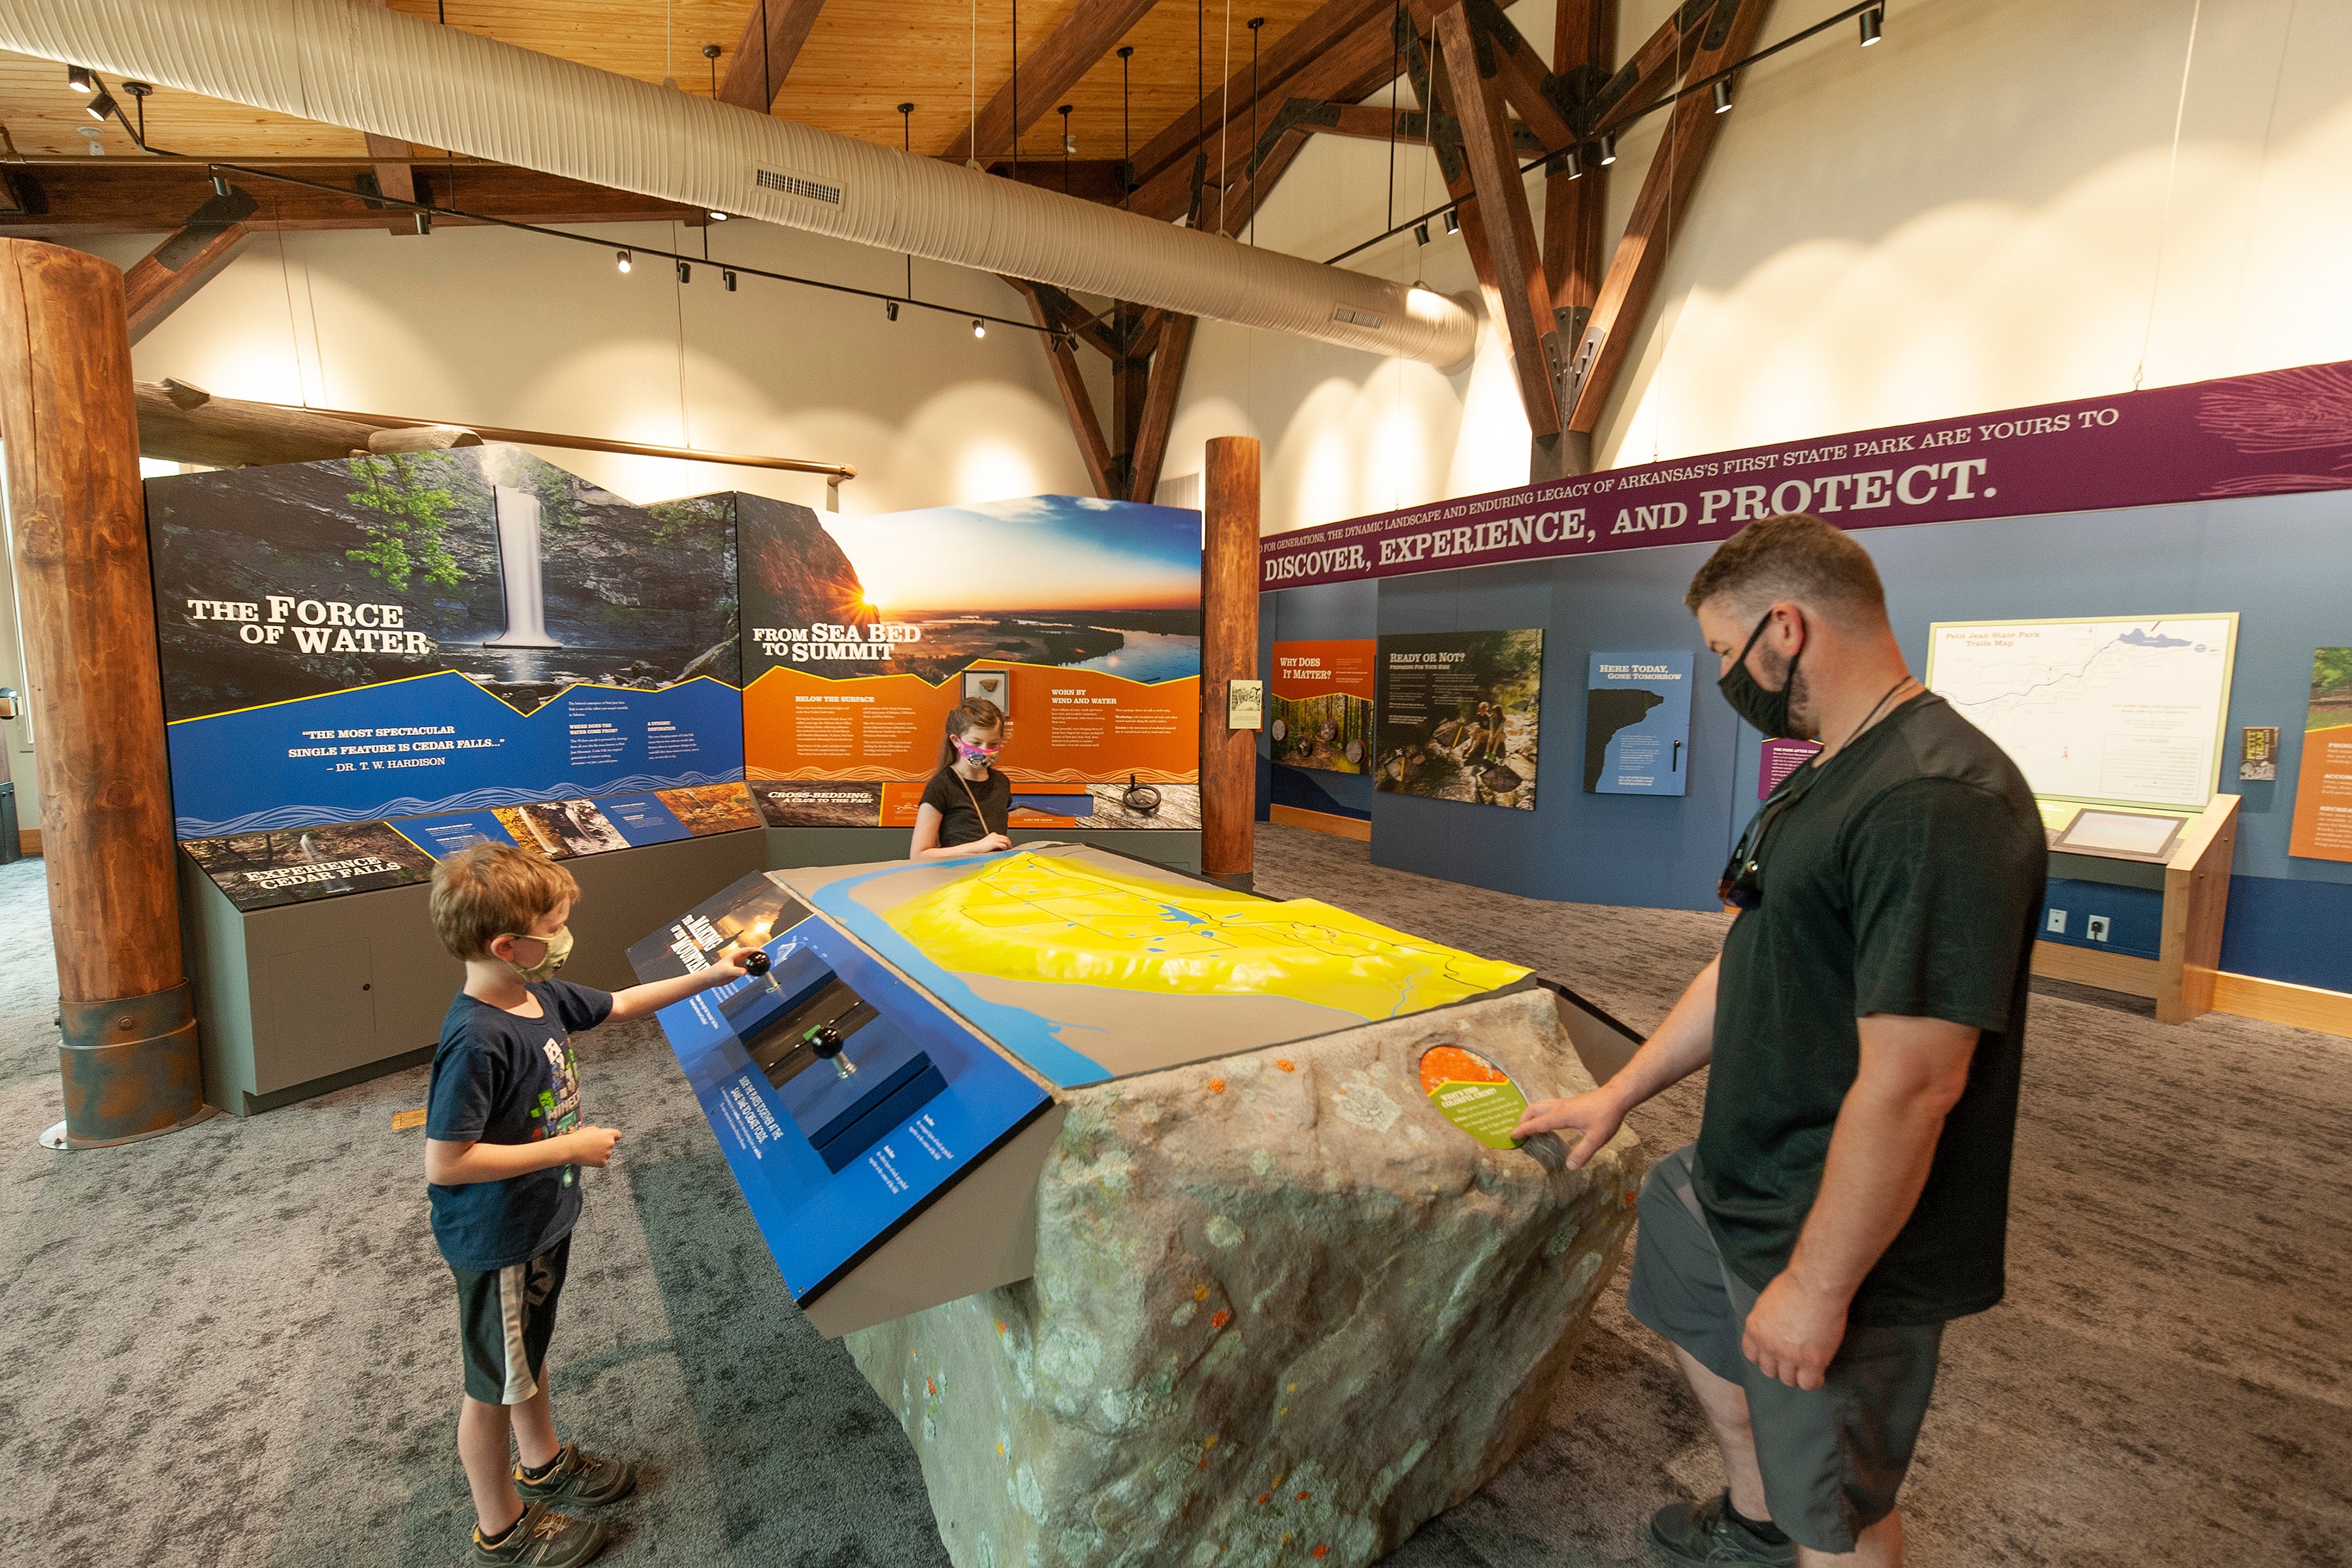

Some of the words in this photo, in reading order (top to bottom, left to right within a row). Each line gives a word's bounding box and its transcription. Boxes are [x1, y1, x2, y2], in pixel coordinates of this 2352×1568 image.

[1264, 542, 1276, 553] FOR
[1277, 533, 1326, 549] GENERATIONS,
[1327, 529, 1343, 541] THE
[1344, 521, 1384, 538] DYNAMIC
[1384, 510, 1441, 531] LANDSCAPE
[1443, 505, 1467, 517] AND
[1469, 493, 1534, 514] ENDURING
[1536, 482, 1592, 503] LEGACY
[1593, 479, 1615, 495] OF
[1722, 453, 1777, 474] FIRST
[1782, 445, 1848, 467] STATE
[1854, 436, 1914, 457] PARK
[1918, 428, 1972, 448] ARE
[1977, 413, 2071, 439] YOURS
[2078, 408, 2121, 428] TO
[1265, 544, 1371, 581] DISCOVER,
[1378, 508, 1597, 566] EXPERIENCE,
[1610, 502, 1688, 536] AND
[1698, 457, 1999, 525] PROTECT.
[187, 599, 259, 622] THE
[265, 595, 404, 629] FORCE
[239, 624, 284, 645] OF
[291, 626, 431, 655] WATER
[753, 628, 808, 642] FROM
[811, 623, 862, 643] SEA
[868, 623, 922, 644] BED
[762, 643, 789, 657] TO
[792, 643, 895, 662] SUMMIT
[1389, 653, 1422, 662] READY
[1422, 653, 1437, 662] OR
[1438, 652, 1465, 662] NOT?
[1280, 657, 1298, 666] WHY
[1298, 657, 1320, 666] DOES
[1599, 664, 1629, 673] HERE
[1631, 664, 1669, 673] TODAY,
[1282, 669, 1292, 679] IT
[1293, 670, 1332, 679] MATTER?
[302, 730, 335, 740] “THE
[337, 728, 373, 739] MOST
[375, 725, 455, 737] SPECTACULAR
[288, 745, 338, 758] SINGLE
[340, 743, 396, 756] FEATURE
[397, 743, 411, 753] IS
[412, 740, 454, 751] CEDAR
[2246, 730, 2256, 759] PETIT
[336, 762, 357, 772] DR.
[359, 761, 370, 771] T.
[372, 760, 385, 770] W.
[387, 757, 446, 769] HARDISON
[243, 856, 382, 882] EXPERIENCE
[259, 871, 336, 890] CEDAR
[339, 862, 403, 879] FALLS
[681, 914, 695, 926] THE
[670, 924, 683, 933] OF
[674, 928, 688, 941] THE
[687, 915, 725, 953] MAKING
[670, 936, 711, 974] MOUNTAI
[739, 1075, 751, 1088] SLIDE
[745, 1084, 756, 1095] THE
[730, 1086, 744, 1102] SAME
[749, 1090, 764, 1107] PLATES
[736, 1096, 749, 1110] TIME
[742, 1105, 752, 1115] TO
[745, 1111, 760, 1130] CREATE
[757, 1102, 776, 1127] TOGETHER
[768, 1123, 779, 1132] AT
[772, 1127, 784, 1141] THE
